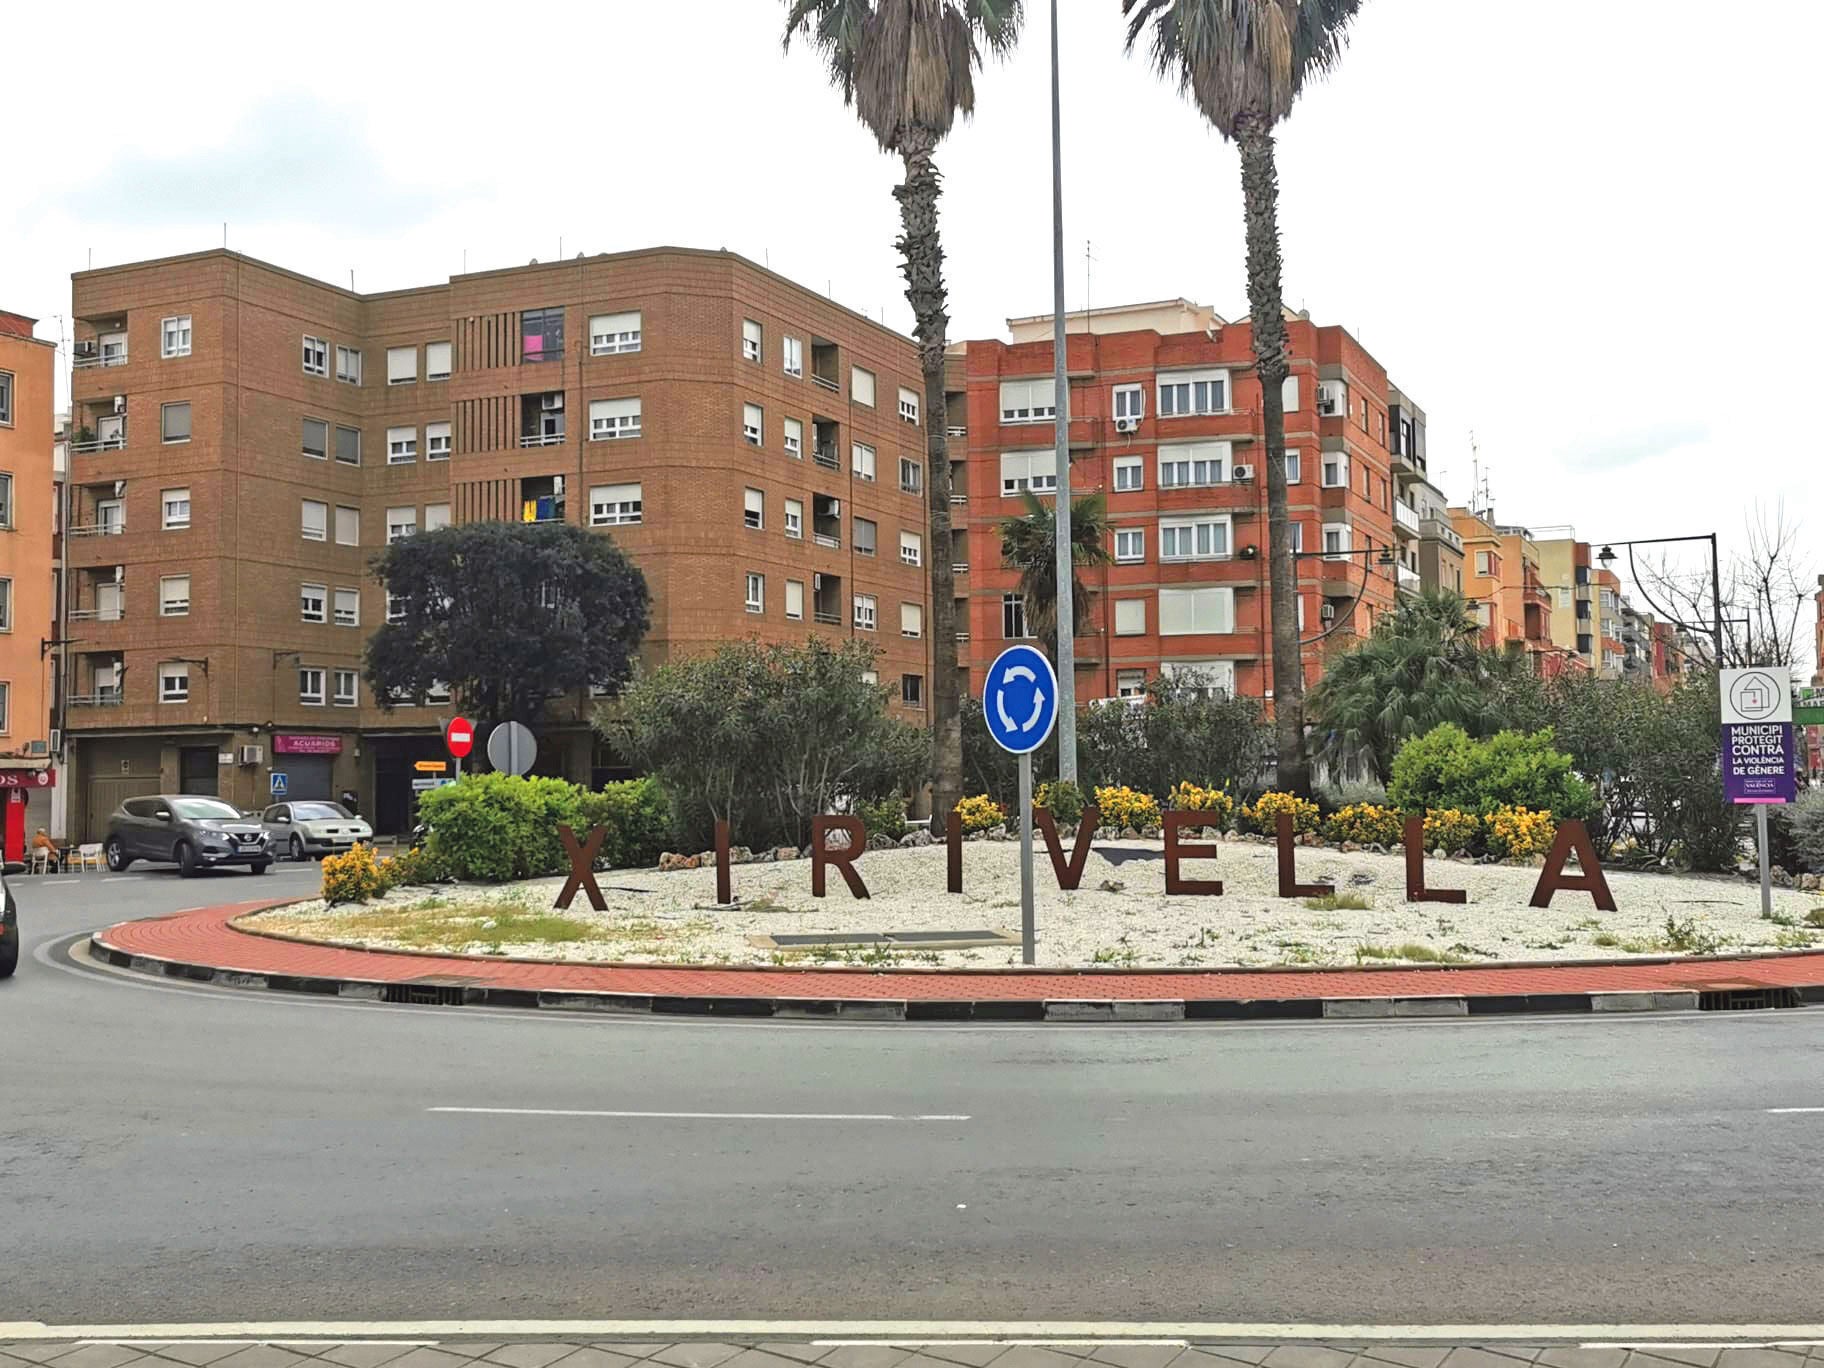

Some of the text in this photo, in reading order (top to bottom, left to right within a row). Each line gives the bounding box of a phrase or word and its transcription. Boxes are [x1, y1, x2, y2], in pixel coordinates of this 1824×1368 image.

[1731, 725, 1783, 736] MUNICIPI
[1731, 735, 1784, 745] PROTEGIT
[1732, 744, 1785, 756] CONTRA
[1732, 757, 1743, 765] LA
[1733, 764, 1785, 776] DE GÈNERE
[553, 807, 1618, 912] XIRIVELLA
